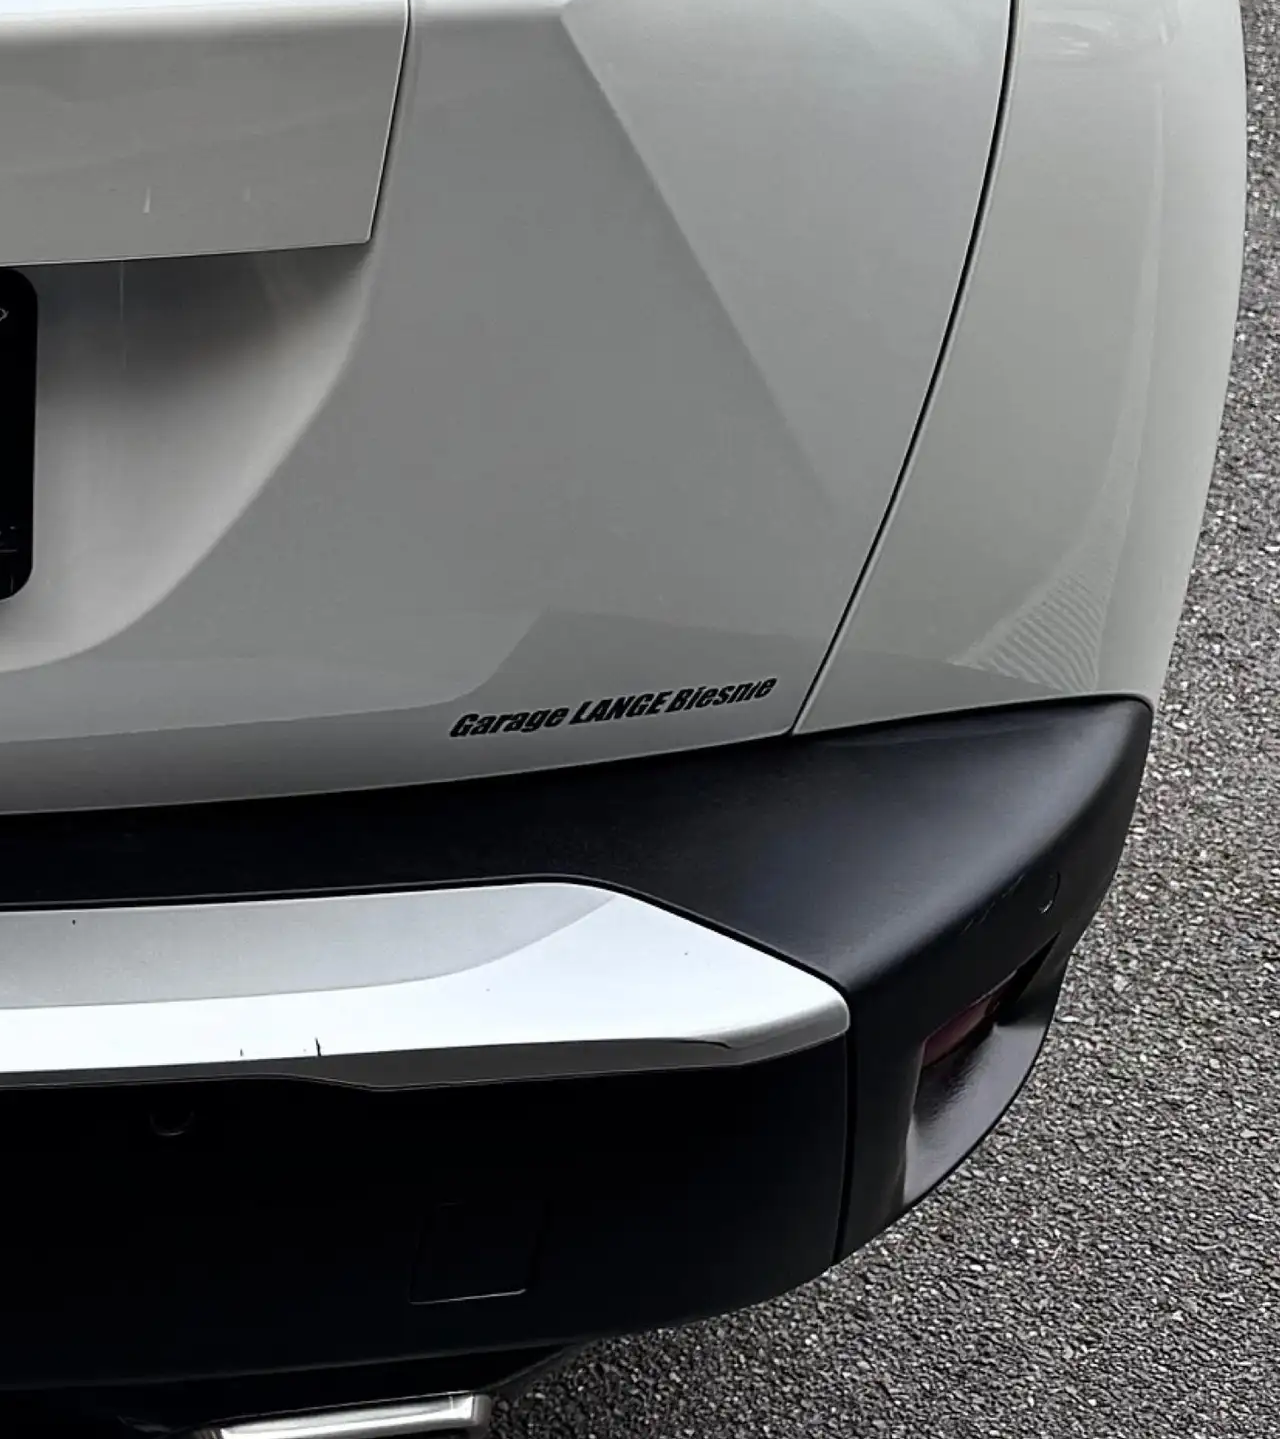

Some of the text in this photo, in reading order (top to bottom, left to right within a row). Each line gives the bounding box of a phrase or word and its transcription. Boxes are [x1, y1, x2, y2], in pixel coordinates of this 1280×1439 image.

[449, 677, 778, 738] Garage LANGE Biesme
